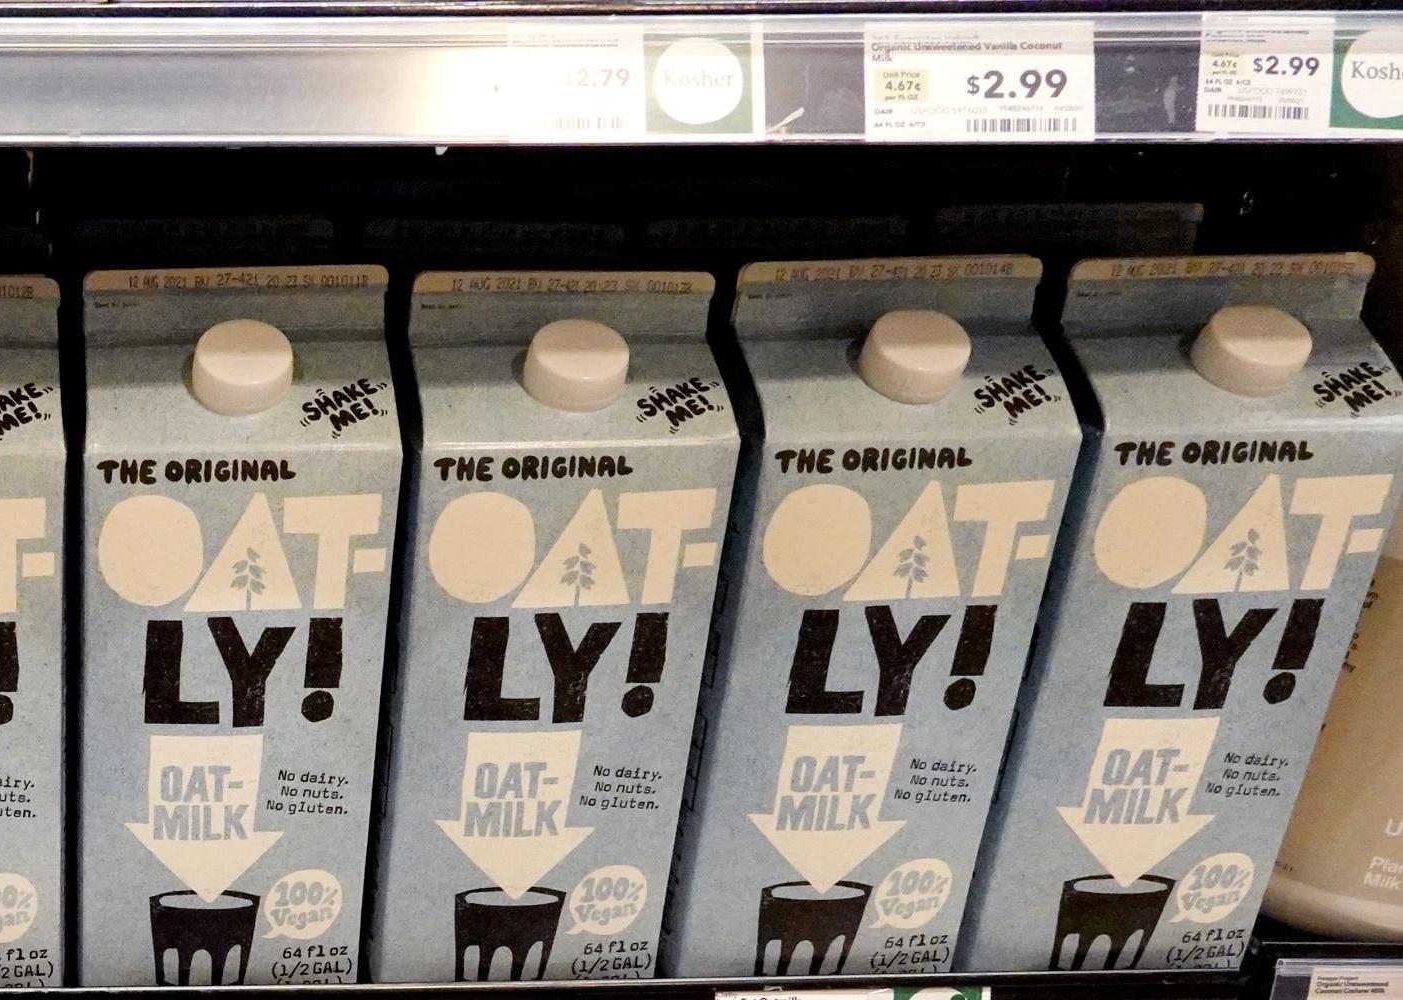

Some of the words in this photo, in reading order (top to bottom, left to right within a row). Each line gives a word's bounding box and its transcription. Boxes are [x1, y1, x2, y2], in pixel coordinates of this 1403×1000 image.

[872, 43, 912, 53] Organic
[914, 42, 981, 51] Unsweetened
[984, 42, 1017, 50] Vanilla
[1020, 41, 1062, 50] Coconut
[872, 54, 893, 63] Milk
[664, 69, 734, 88] Kosher
[1253, 55, 1320, 76] $2.99
[885, 81, 921, 91] 4.67¢
[967, 69, 1068, 98] $2.99
[1114, 441, 1175, 466] THE
[1182, 440, 1314, 465] ORIGINAL
[428, 487, 718, 609] OAT-
[1093, 473, 1394, 594] OAT-
[463, 612, 670, 724] LY!
[1103, 598, 1326, 710] LY!
[1102, 749, 1189, 786] OAT-
[1084, 788, 1188, 825] MILK
